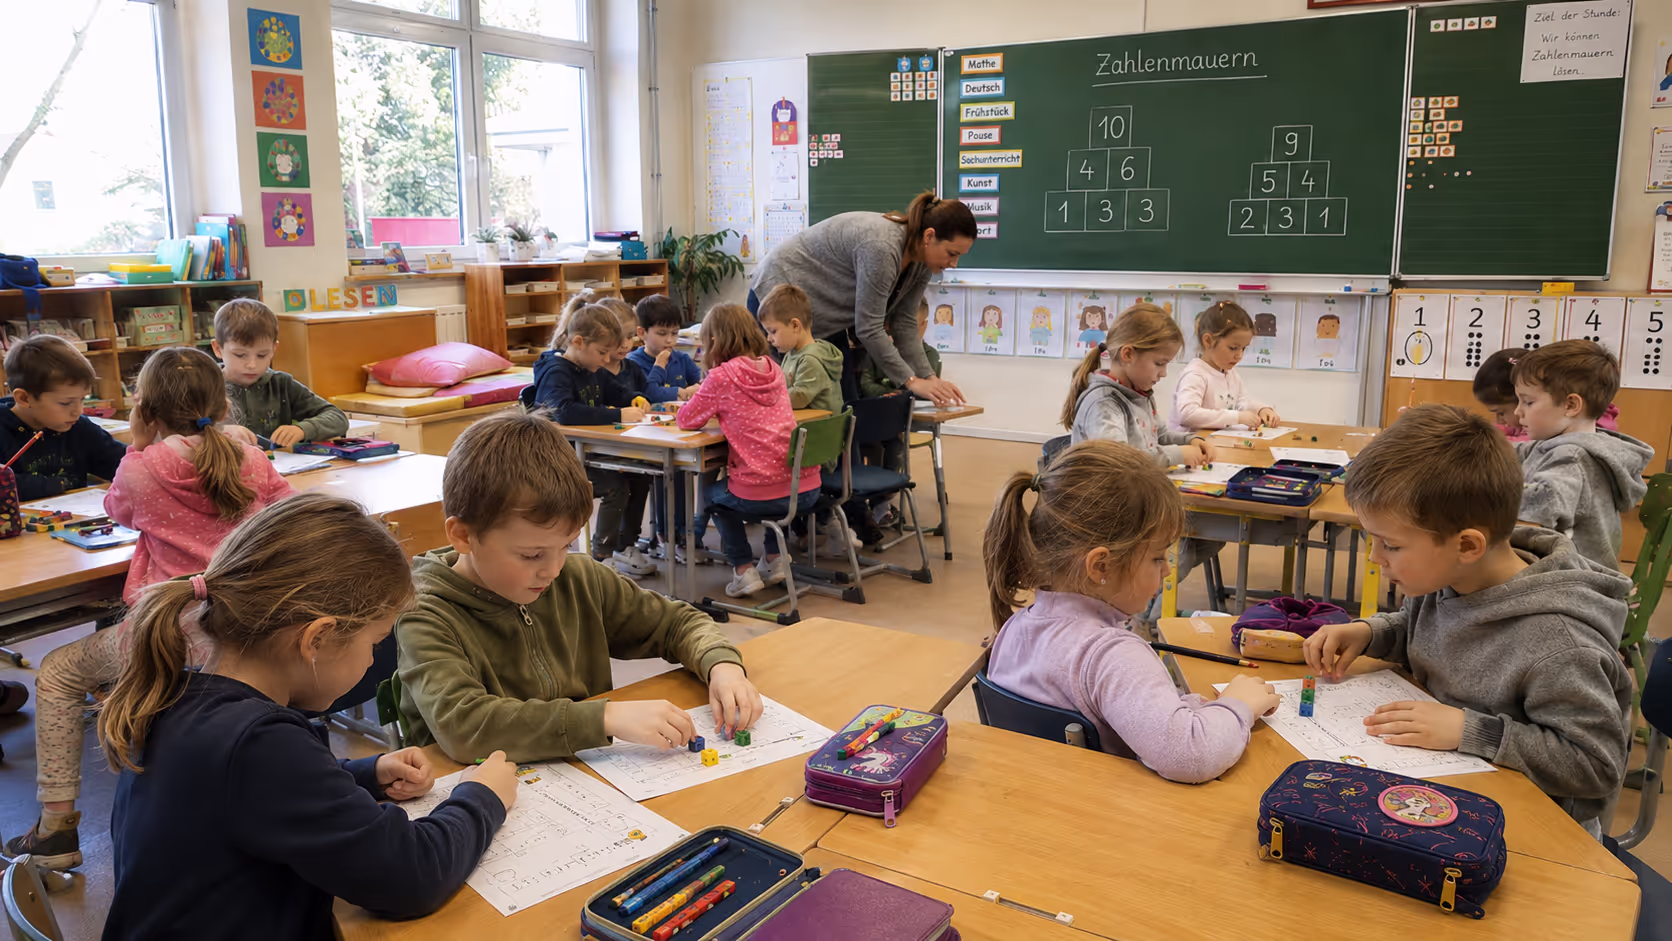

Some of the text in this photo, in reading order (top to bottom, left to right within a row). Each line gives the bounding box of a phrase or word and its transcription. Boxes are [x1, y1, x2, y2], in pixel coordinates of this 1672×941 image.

[1534, 8, 1620, 22] Ziel der Stunde:
[1541, 32, 1600, 42] Wir können
[1096, 48, 1259, 76] Zahlenmauern
[1531, 49, 1614, 61] Zahlenmauern
[1553, 65, 1584, 76] lösen.
[965, 82, 1000, 93] Deutsch
[965, 106, 1009, 118] Frühstück
[1098, 115, 1125, 139] 10
[1285, 131, 1298, 156] 9
[1080, 155, 1135, 181] 4 6
[967, 178, 992, 188] Kunst
[1261, 169, 1315, 193] 5 4
[967, 202, 992, 211] Musik
[1057, 198, 1154, 223] 1 3 3
[1240, 205, 1329, 229] 2 3 1
[977, 226, 991, 235] ort
[310, 284, 397, 311] LESEN
[1413, 306, 1426, 327] 1
[1468, 307, 1484, 328] 2
[1526, 308, 1541, 329] 3
[1585, 309, 1602, 331] 4
[1647, 311, 1664, 333] 5
